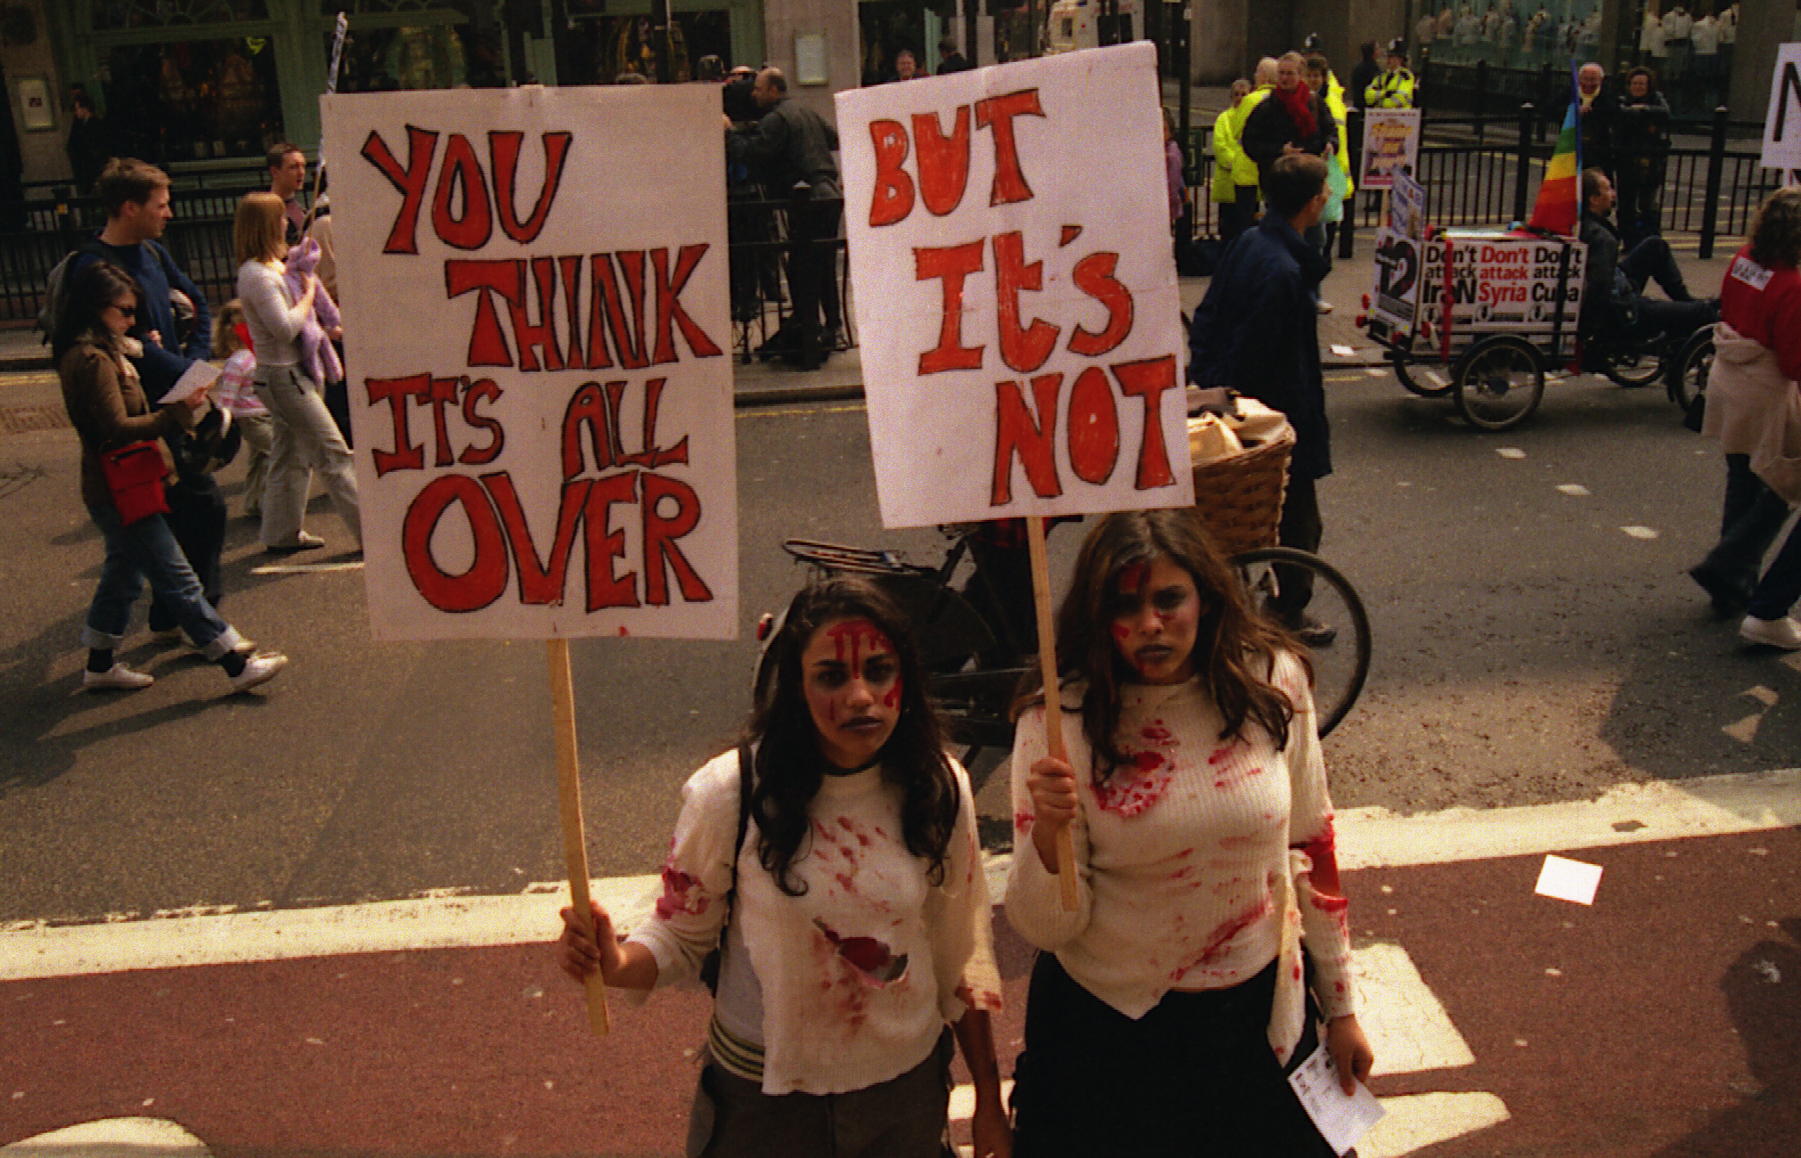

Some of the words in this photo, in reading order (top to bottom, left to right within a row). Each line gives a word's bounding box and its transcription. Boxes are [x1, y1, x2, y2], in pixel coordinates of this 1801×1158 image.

[361, 124, 573, 255] YOU
[869, 88, 1046, 227] BUT
[444, 243, 723, 371] THINK
[912, 225, 1135, 376] It's
[1478, 281, 1526, 307] Syria
[1480, 246, 1529, 263] Don't
[1480, 265, 1527, 280] attack
[1533, 282, 1579, 302] Cua
[1535, 246, 1582, 263] Do't
[364, 372, 504, 478] IT'S
[561, 377, 688, 480] ALL
[990, 353, 1177, 506] NOT
[403, 470, 713, 613] OVER
